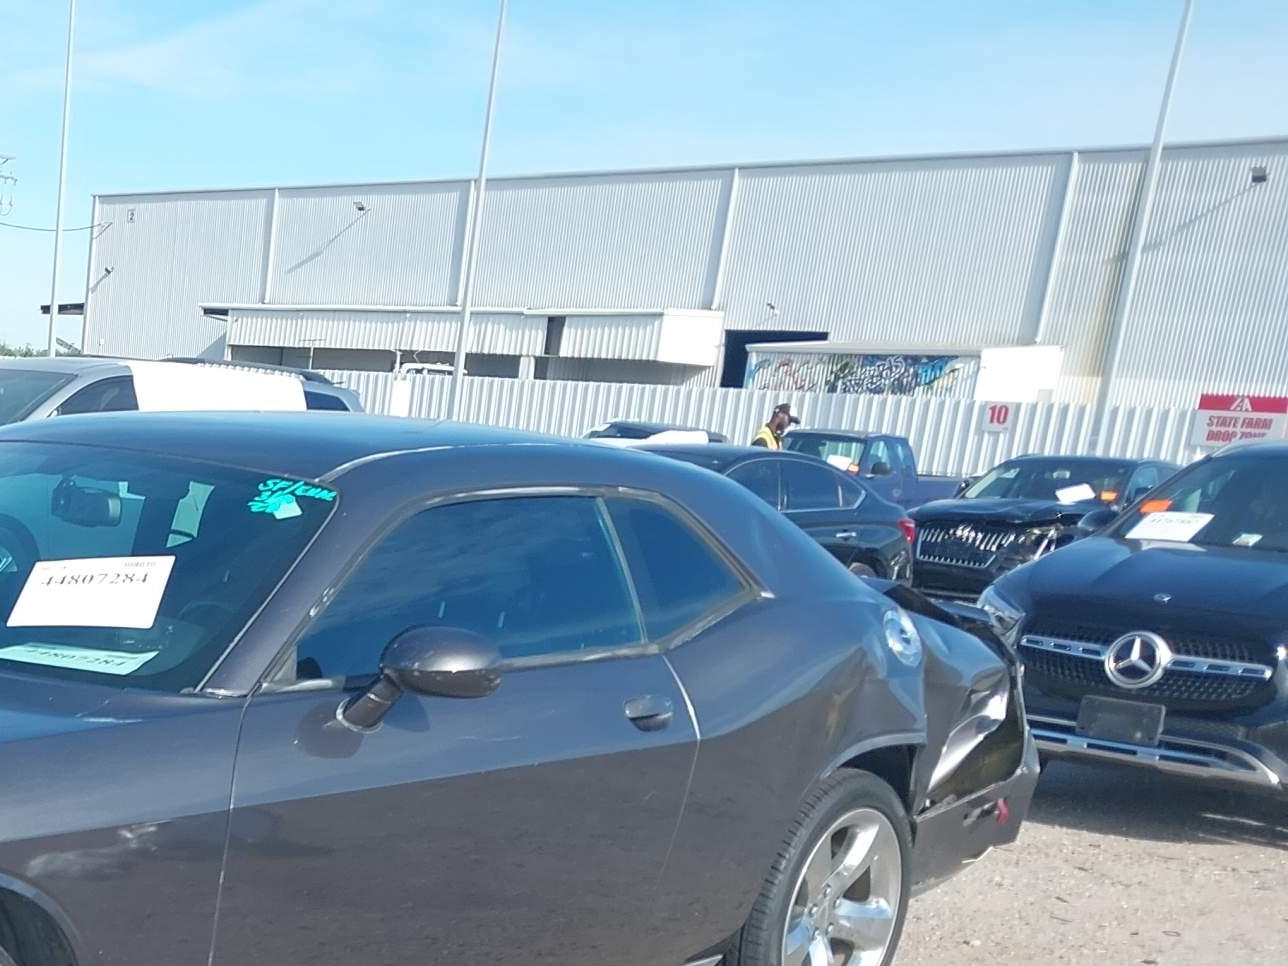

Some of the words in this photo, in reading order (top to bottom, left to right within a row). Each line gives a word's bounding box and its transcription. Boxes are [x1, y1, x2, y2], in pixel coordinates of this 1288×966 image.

[989, 404, 1009, 424] 10
[1207, 416, 1240, 428] STATE
[1240, 417, 1273, 430] FARM
[1207, 430, 1238, 443] DROP
[41, 572, 148, 587] 44807284
